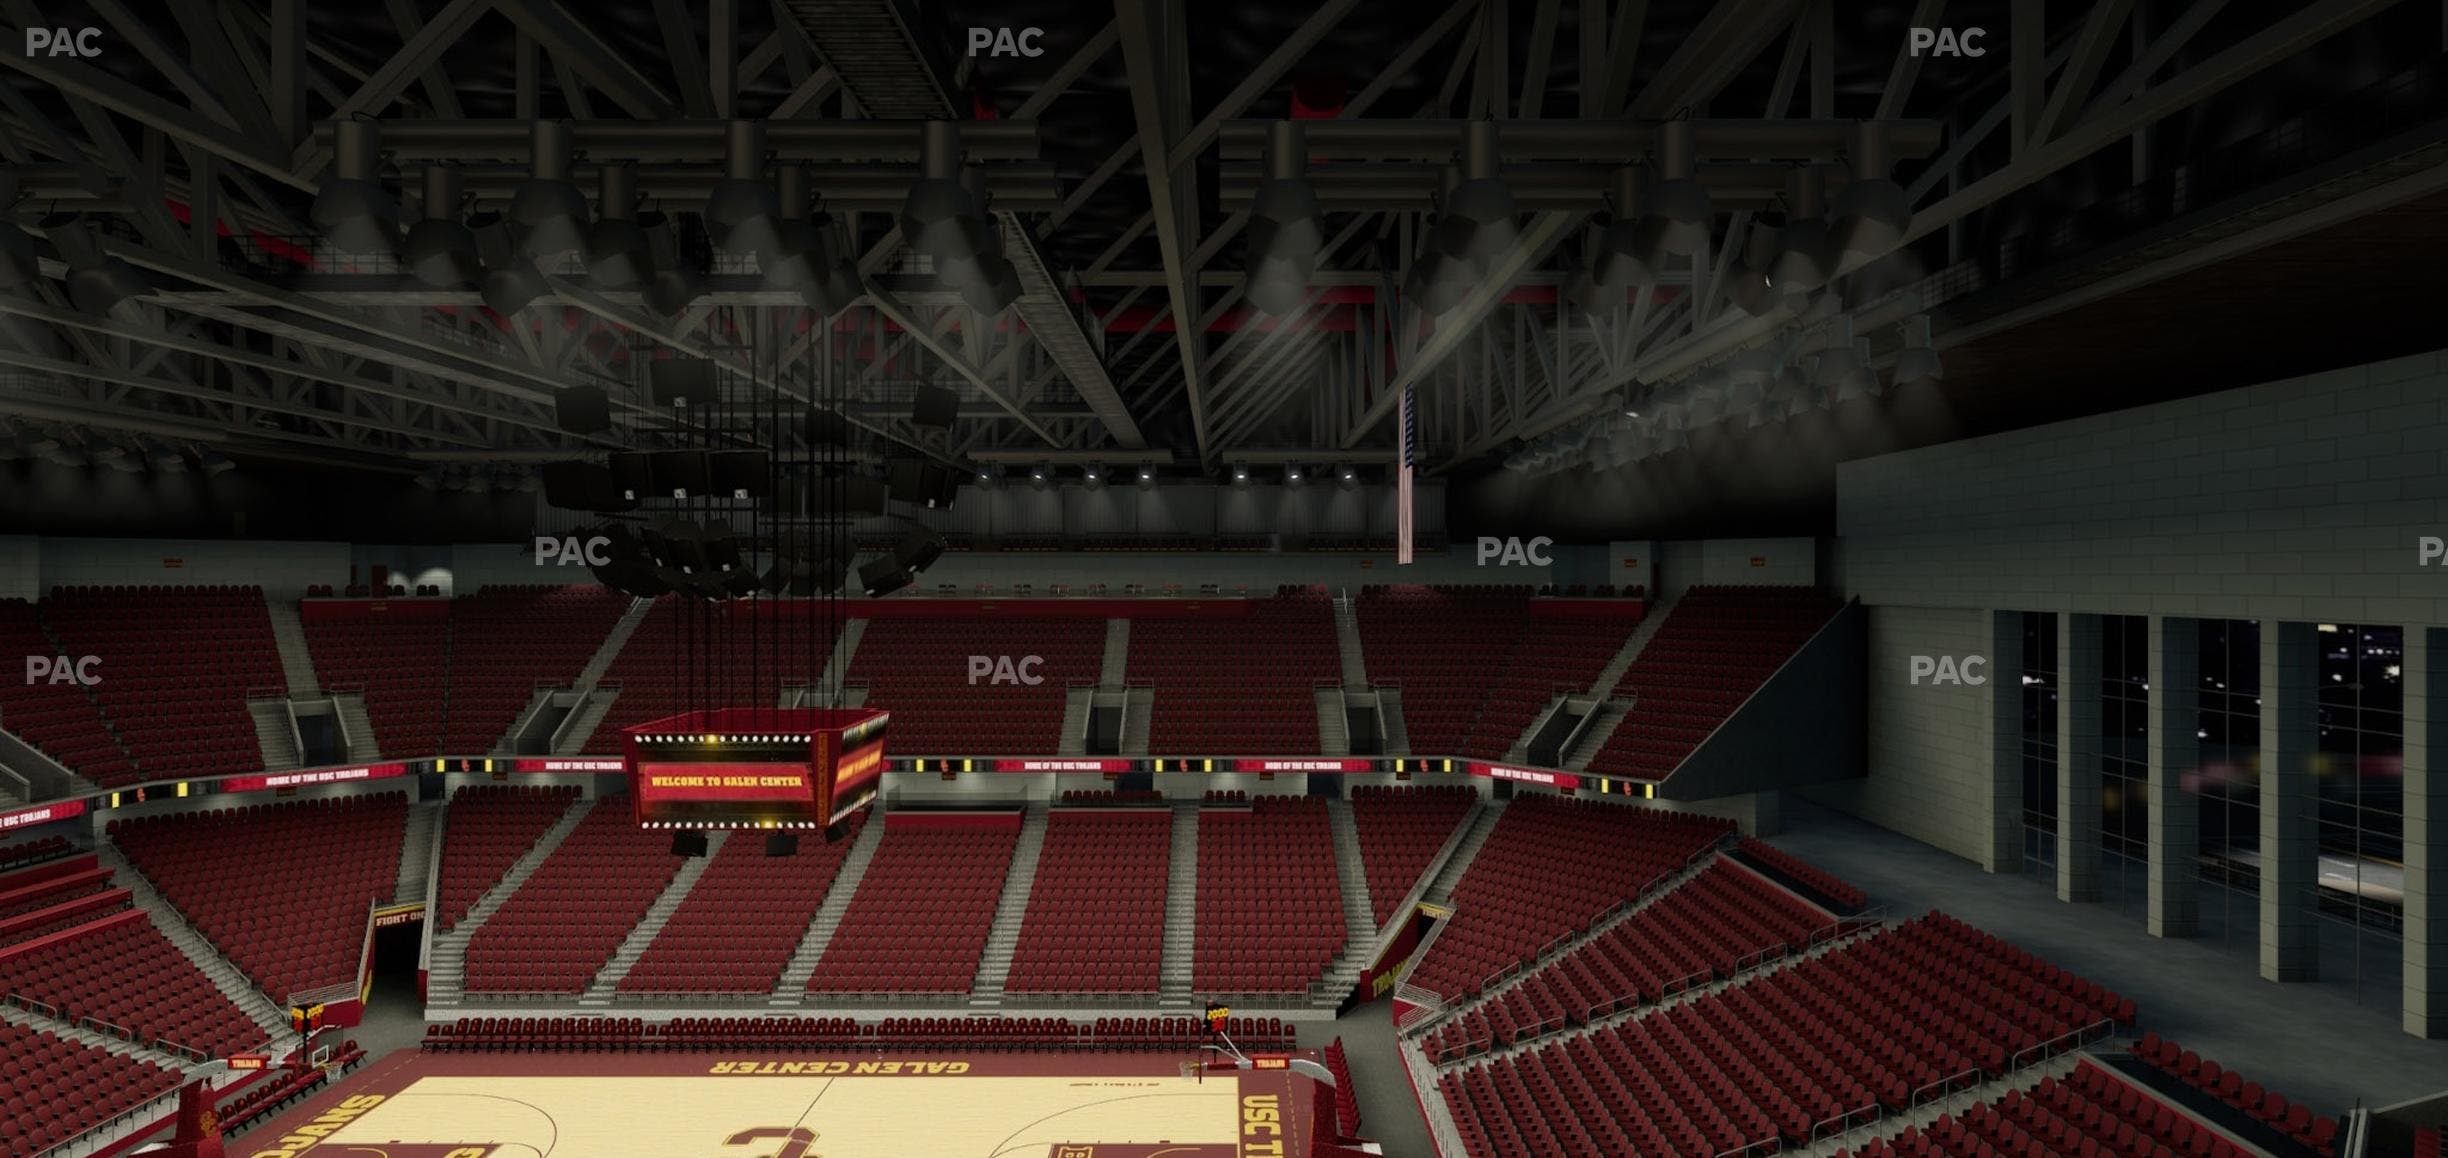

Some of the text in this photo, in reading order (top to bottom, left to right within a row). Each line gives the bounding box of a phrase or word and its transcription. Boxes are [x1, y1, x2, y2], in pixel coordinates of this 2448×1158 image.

[318, 772, 335, 781] USC
[651, 776, 802, 787] WELCOME TO GALEN CENTER
[375, 913, 408, 926] FIGHT
[709, 1060, 970, 1075] GALEN CENTER
[1243, 1094, 1281, 1135] USC
